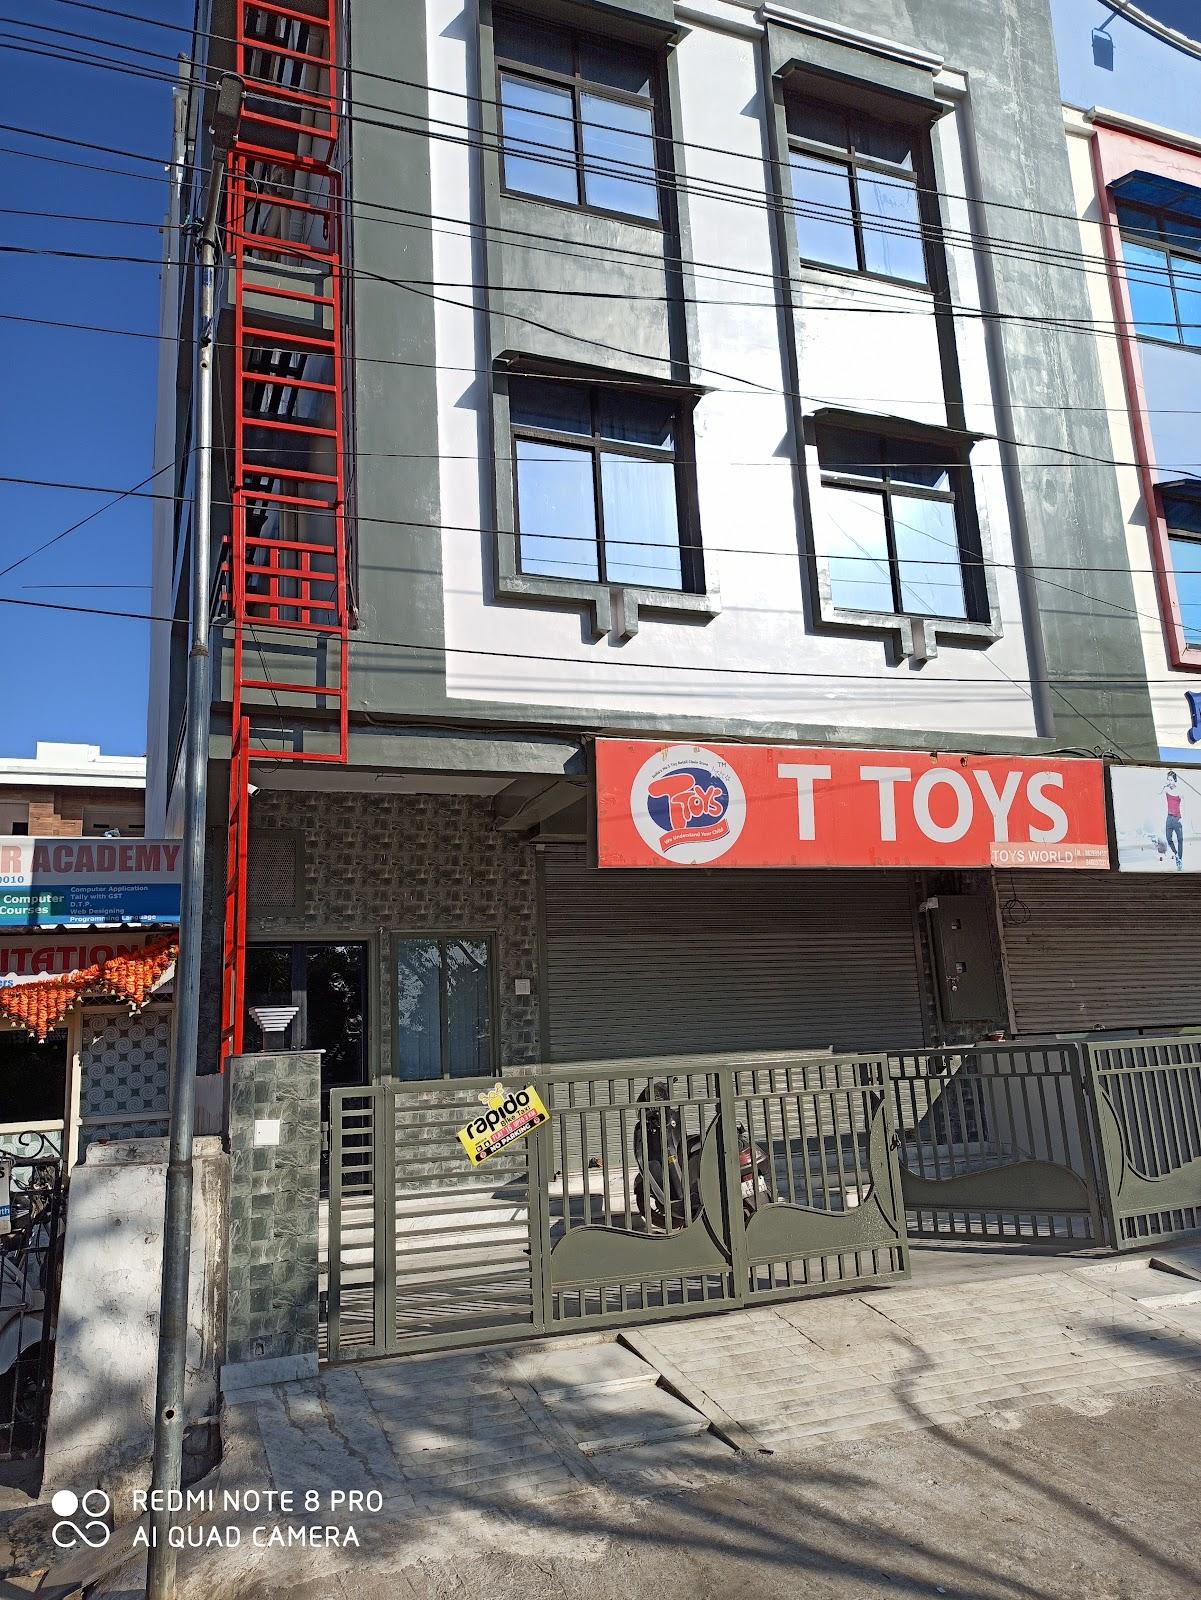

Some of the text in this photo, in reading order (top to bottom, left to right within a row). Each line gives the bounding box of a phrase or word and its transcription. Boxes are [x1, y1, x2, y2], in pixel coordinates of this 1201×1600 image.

[778, 764, 1069, 844] T TOYS
[30, 845, 181, 873] ACADEMY
[992, 850, 1025, 861] TOYS
[1028, 851, 1073, 863] WORLD
[0, 875, 25, 884] 010
[3, 894, 65, 905] Computer
[0, 906, 49, 915] Courses
[466, 1091, 529, 1139] rapido
[500, 1105, 531, 1126] Bike Taxi
[490, 1142, 501, 1152] NO
[501, 1124, 531, 1145] PARKING
